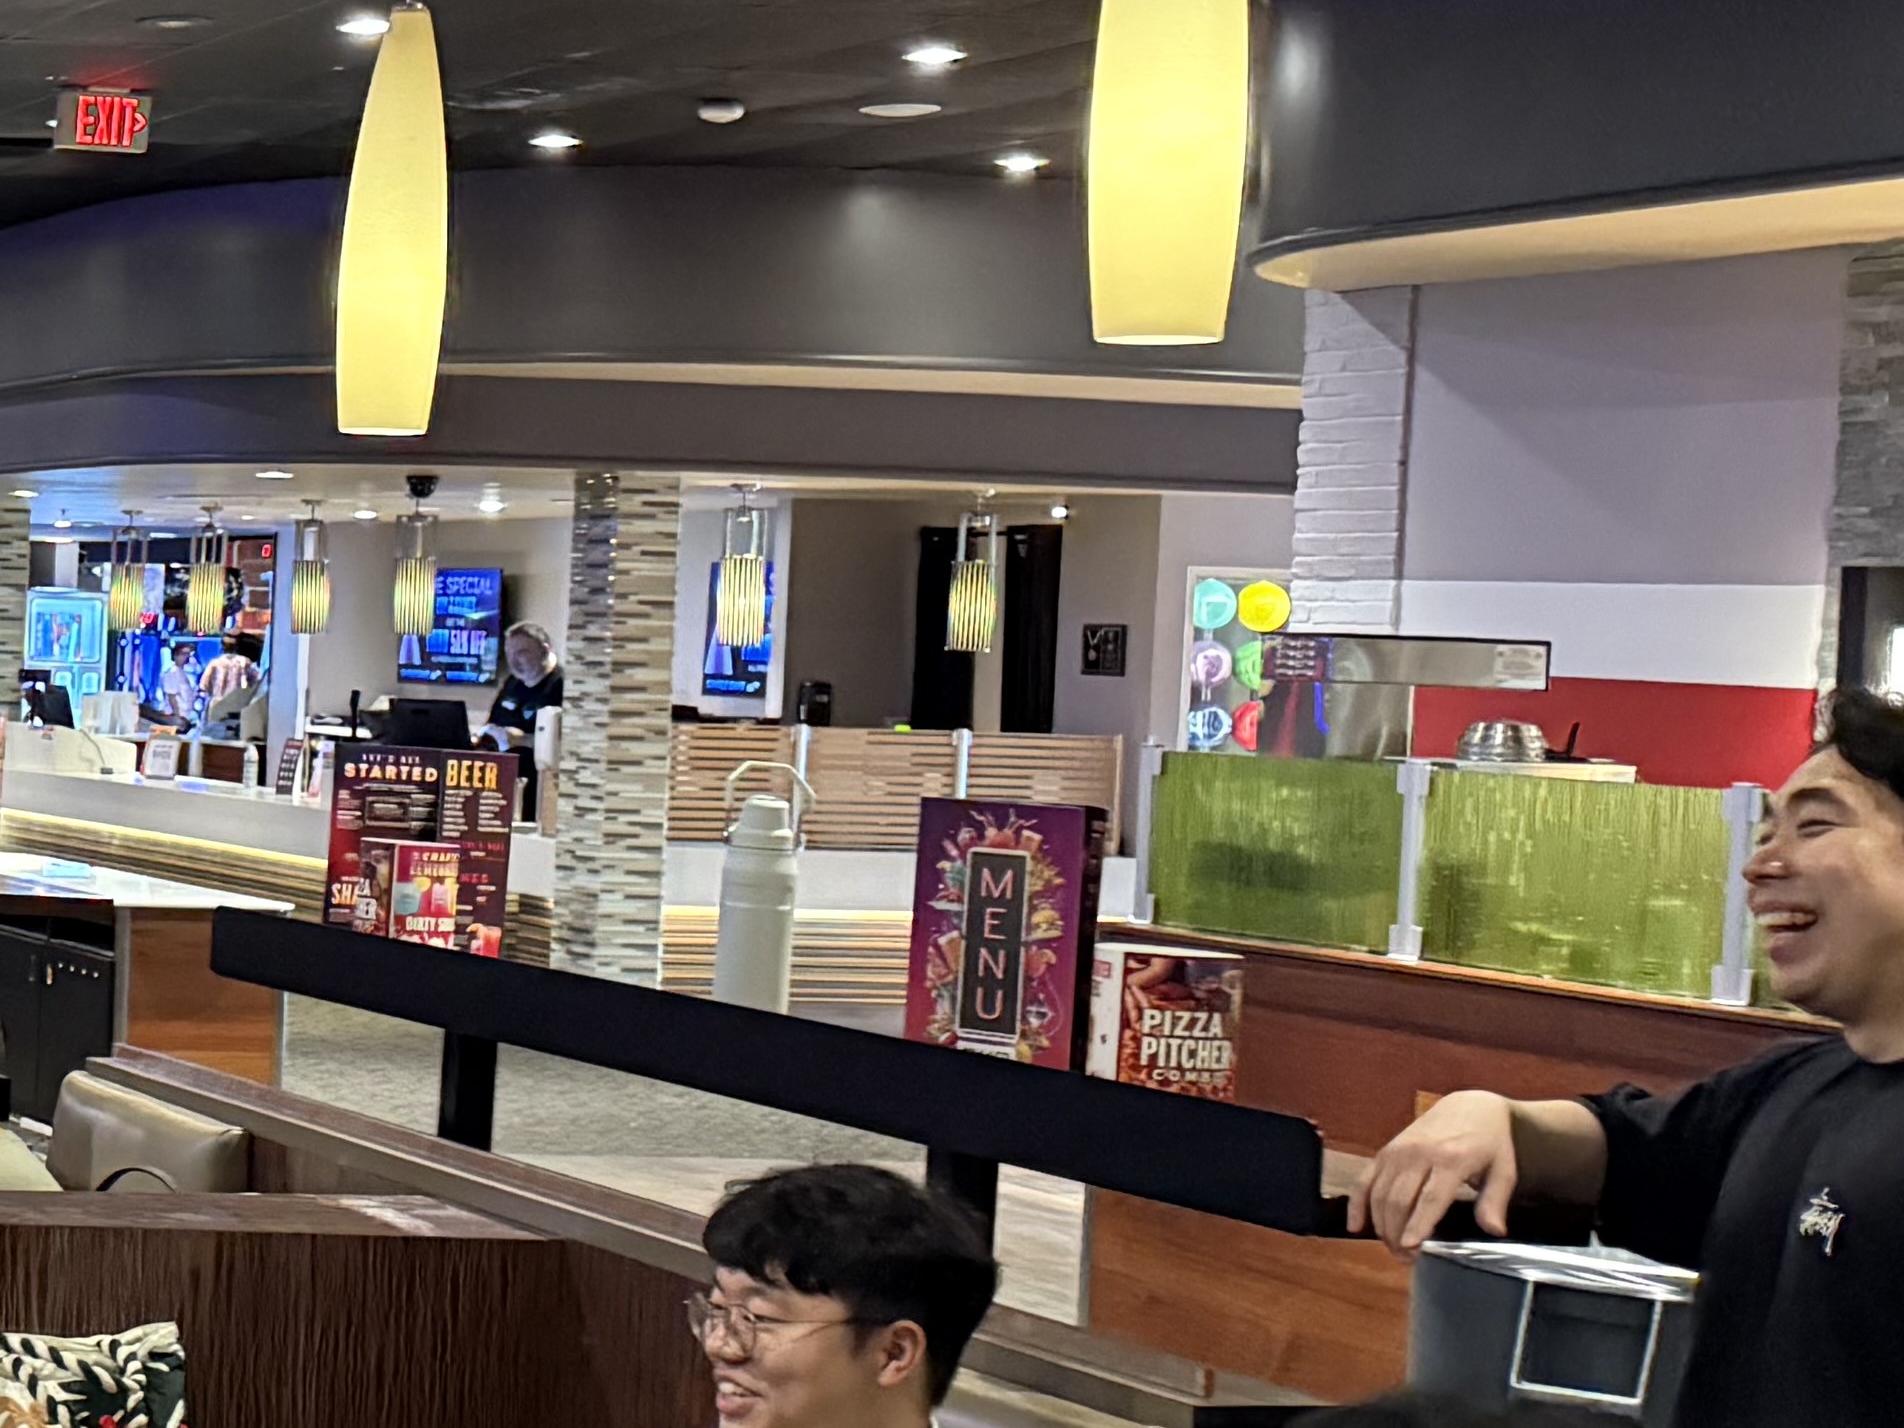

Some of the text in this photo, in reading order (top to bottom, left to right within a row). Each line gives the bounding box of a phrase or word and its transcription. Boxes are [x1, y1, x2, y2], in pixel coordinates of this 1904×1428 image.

[75, 95, 138, 147] EXIT
[343, 762, 438, 783] STARTED
[445, 759, 499, 790] BEER
[975, 867, 1013, 1021] MENU
[1142, 1008, 1224, 1039] PIZZA
[1139, 1036, 1233, 1070] PITCHER
